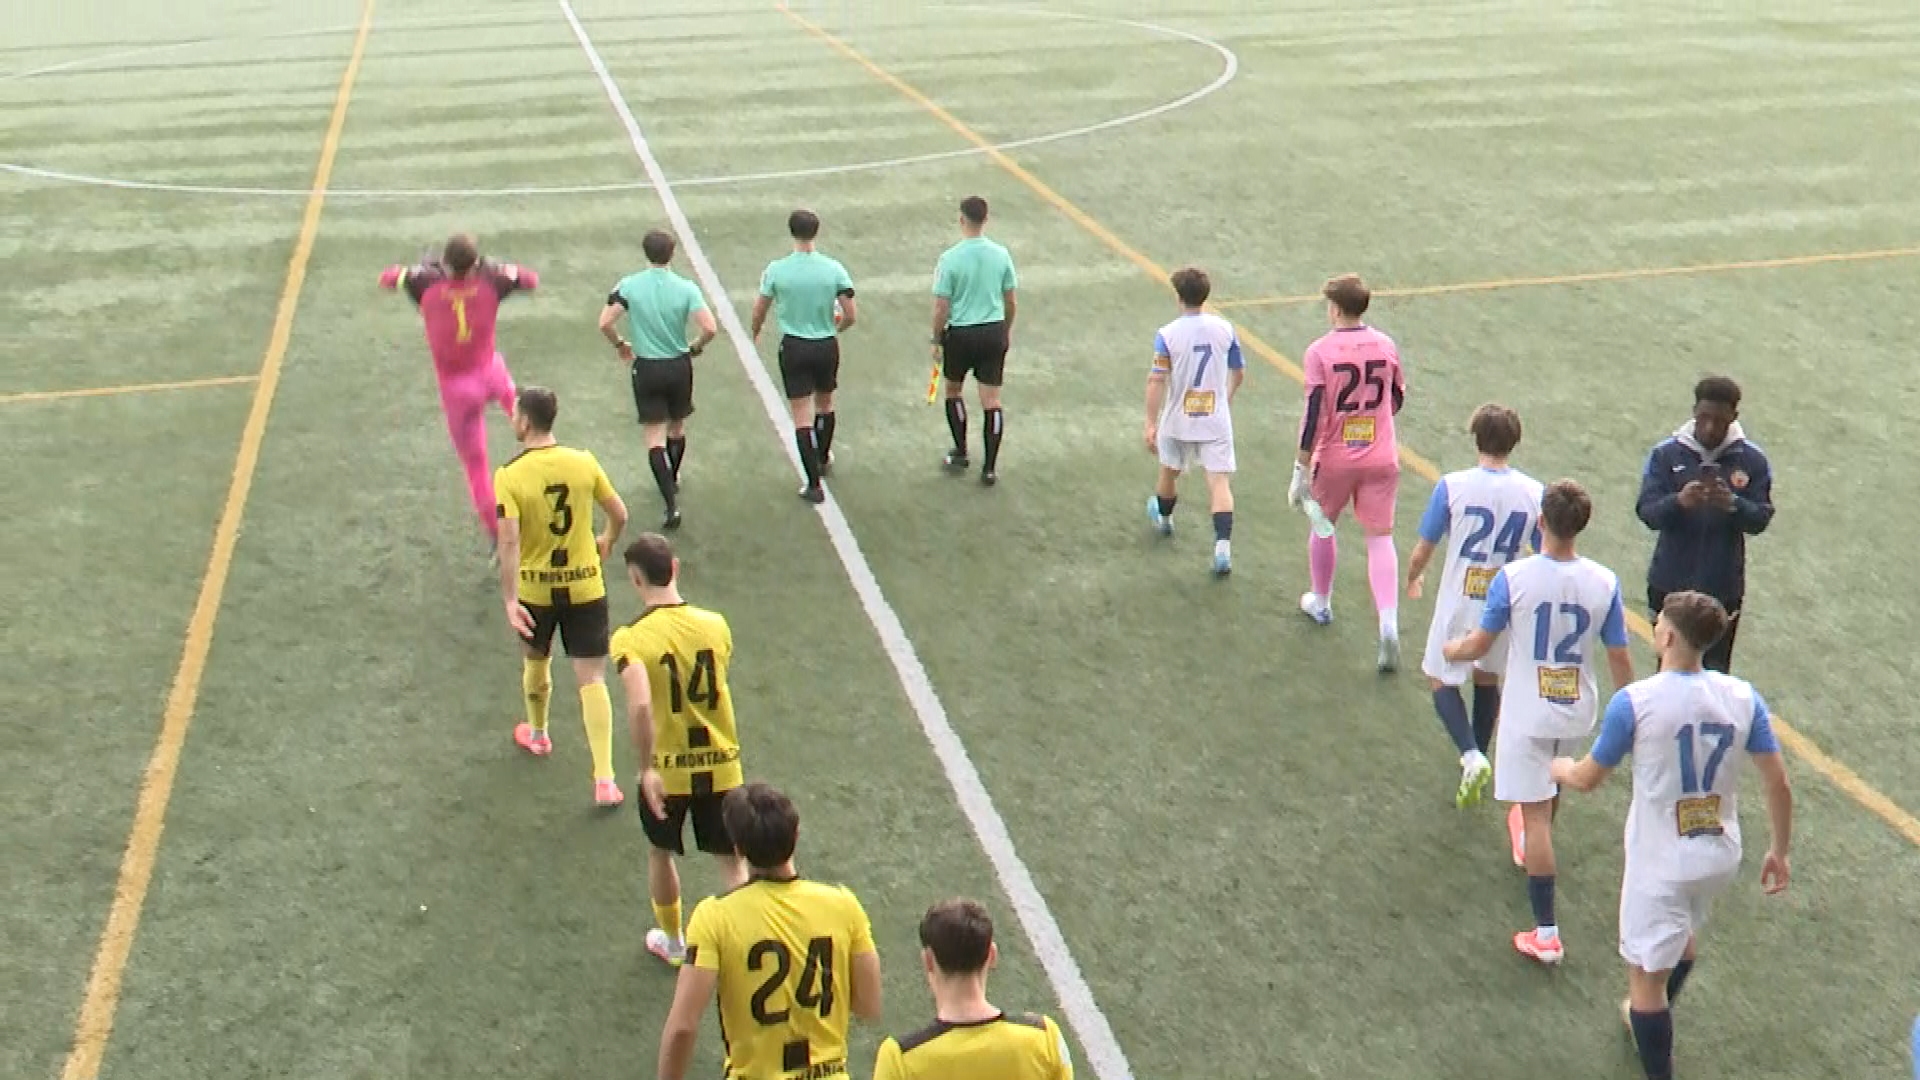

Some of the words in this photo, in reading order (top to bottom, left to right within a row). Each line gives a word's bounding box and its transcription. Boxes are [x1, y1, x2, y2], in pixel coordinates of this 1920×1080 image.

[453, 299, 472, 343] 1
[1193, 344, 1212, 387] 7
[1333, 359, 1387, 412] 25
[544, 483, 572, 536] 3
[1460, 506, 1528, 563] 24
[1534, 601, 1591, 664] 12
[659, 648, 719, 713] 14
[1675, 721, 1734, 793] 17
[747, 935, 833, 1026] 24
